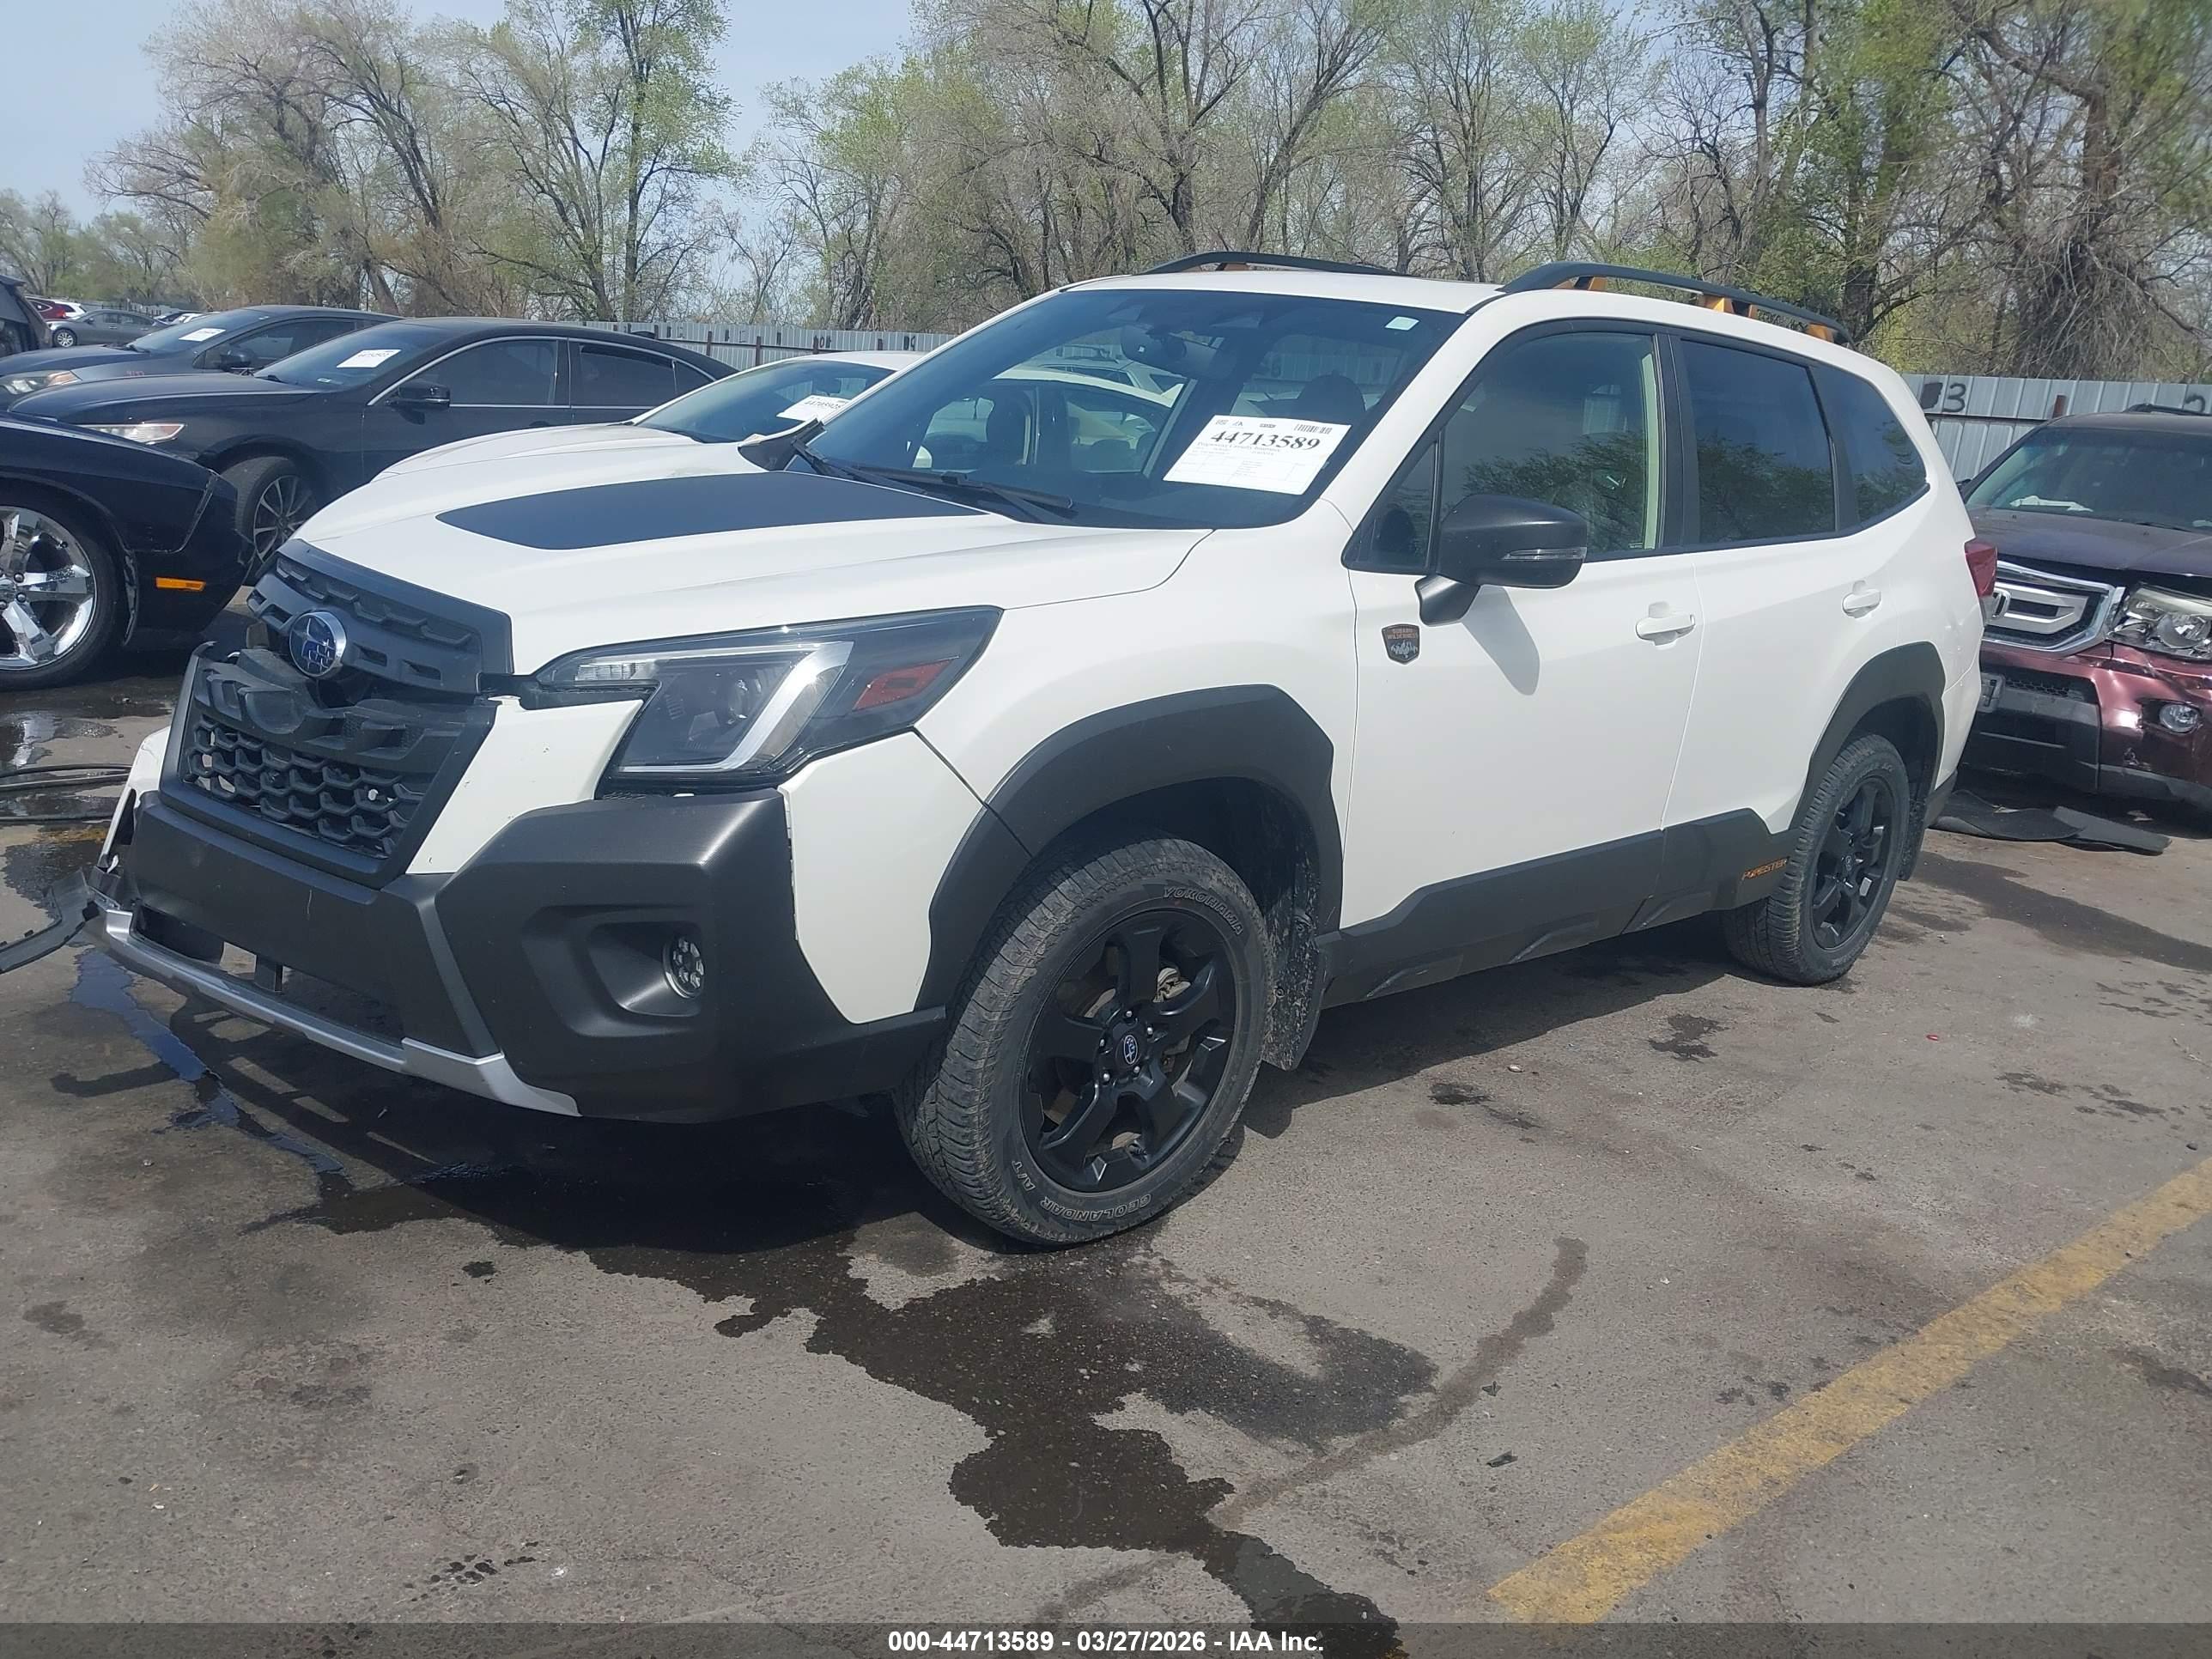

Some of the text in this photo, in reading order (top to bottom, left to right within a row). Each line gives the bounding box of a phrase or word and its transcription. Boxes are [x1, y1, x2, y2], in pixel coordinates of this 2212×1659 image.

[1942, 383, 1966, 412] 3
[1211, 431, 1321, 451] 44713589
[1164, 885, 1244, 935] YOKOHAMA
[1040, 1194, 1152, 1222] GEOLANDAR
